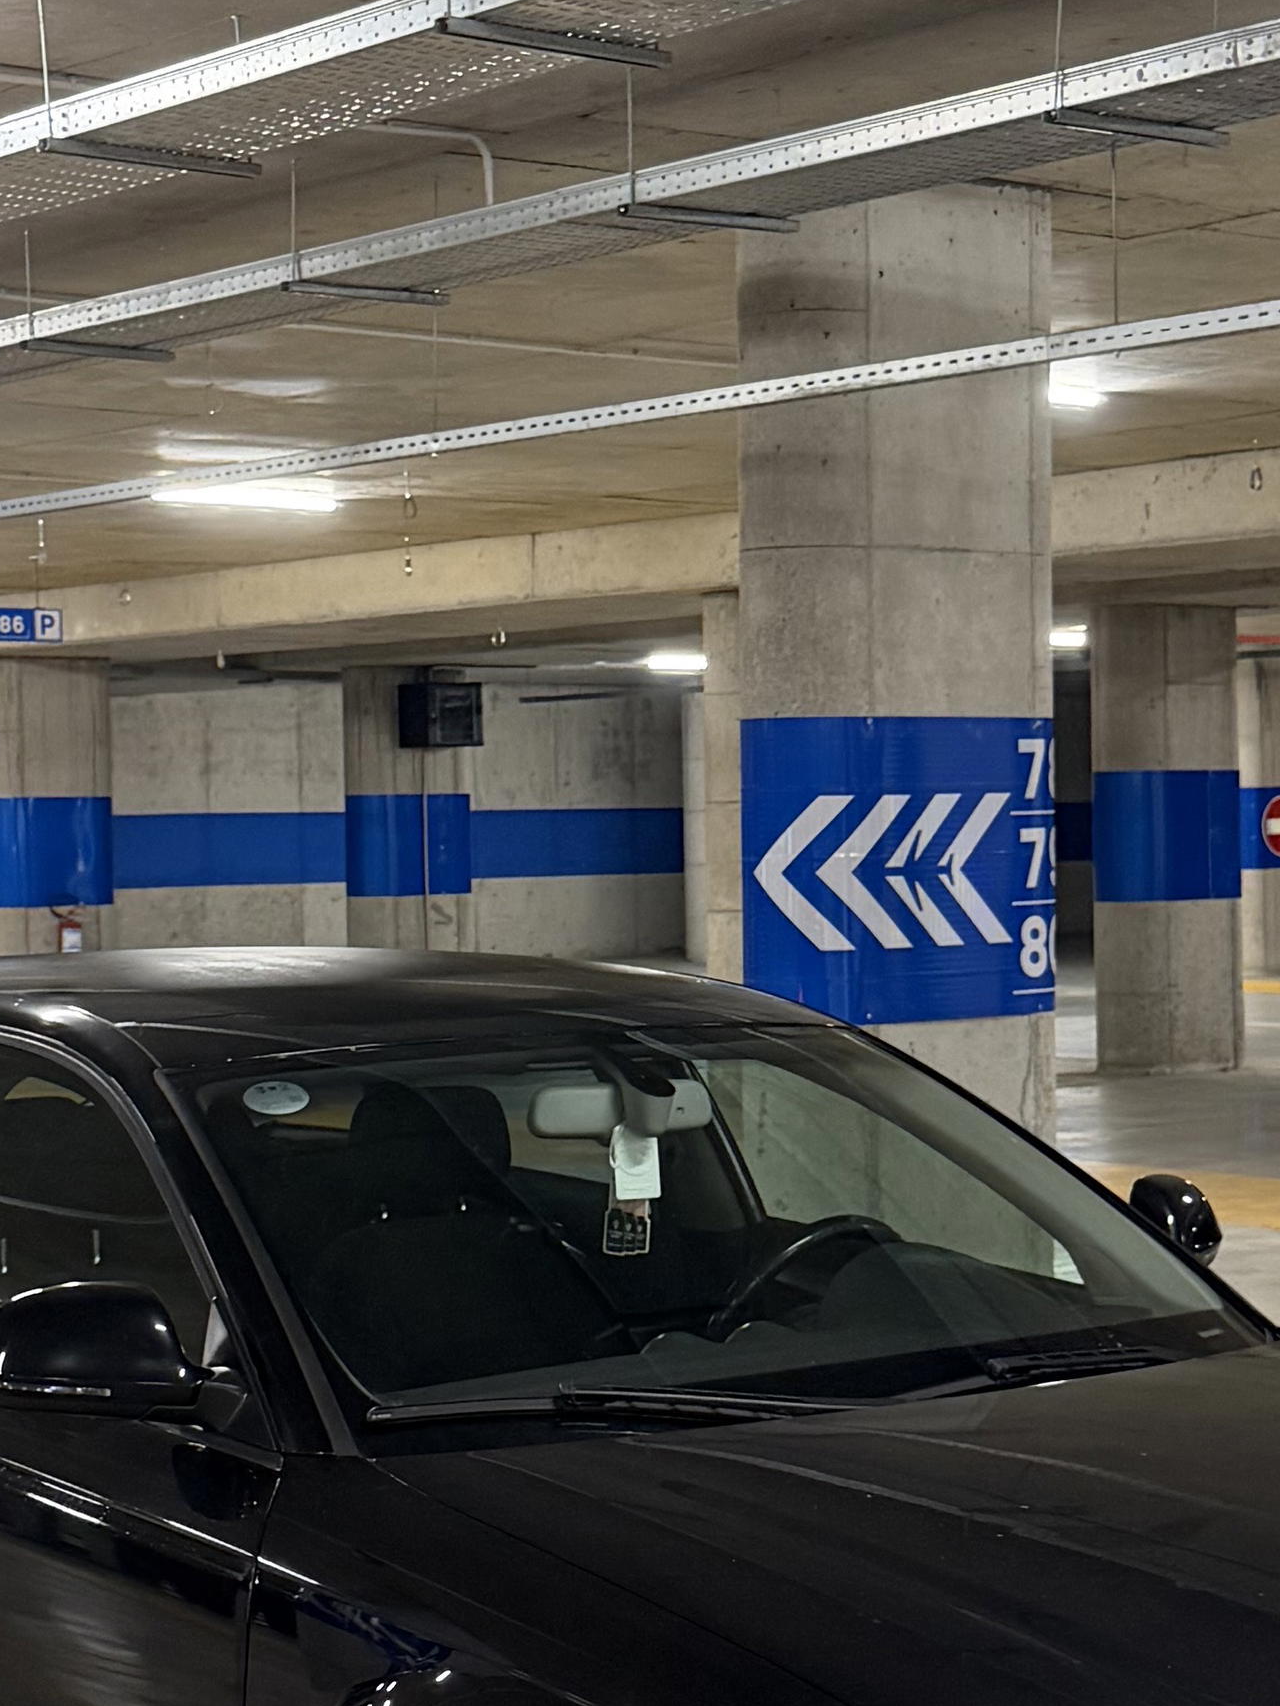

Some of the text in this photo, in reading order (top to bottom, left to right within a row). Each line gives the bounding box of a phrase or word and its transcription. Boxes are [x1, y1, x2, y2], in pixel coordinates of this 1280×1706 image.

[40, 614, 56, 636] P
[1018, 737, 1056, 800] 7
[1019, 825, 1056, 889] 7
